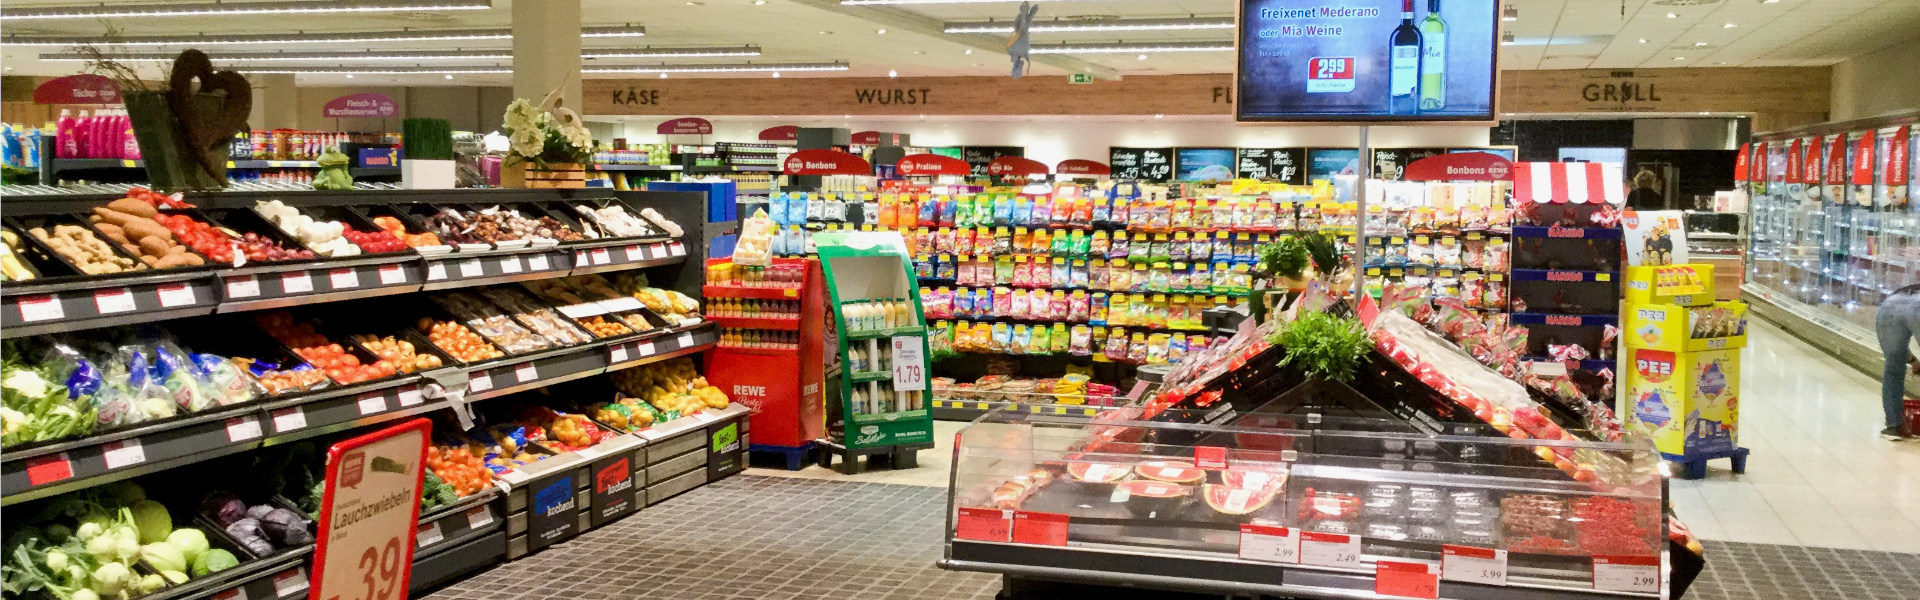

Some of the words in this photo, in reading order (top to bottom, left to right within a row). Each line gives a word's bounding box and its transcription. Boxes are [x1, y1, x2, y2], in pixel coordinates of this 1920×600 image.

[1261, 8, 1316, 19] Freixenet
[1320, 6, 1378, 17] Mederano
[1260, 29, 1278, 37] oder
[1282, 26, 1302, 36] Mia
[1306, 25, 1342, 36] Weine
[1318, 58, 1346, 79] 2.99
[612, 86, 660, 105] KÄSE
[855, 88, 931, 105] WURST
[805, 161, 837, 170] Bonbons
[915, 163, 942, 171] Pralinen
[1446, 165, 1485, 175] Bonbons
[1487, 166, 1508, 174] REWE
[1547, 228, 1584, 239] HARIBO
[1546, 271, 1583, 282] HARIBO
[1545, 315, 1582, 326] HARIBO
[1637, 309, 1665, 321] PEZ
[1636, 358, 1671, 375] PEZ
[896, 364, 921, 384] 1.79
[733, 384, 766, 397] REWE
[607, 476, 632, 496] kochend
[333, 488, 411, 531] Lauchzwiebeln
[547, 496, 575, 517] kochend
[1274, 547, 1294, 557] 2.99
[1336, 553, 1356, 563] 2.49
[1480, 569, 1502, 579] 3.99
[1633, 576, 1655, 586] 2.99
